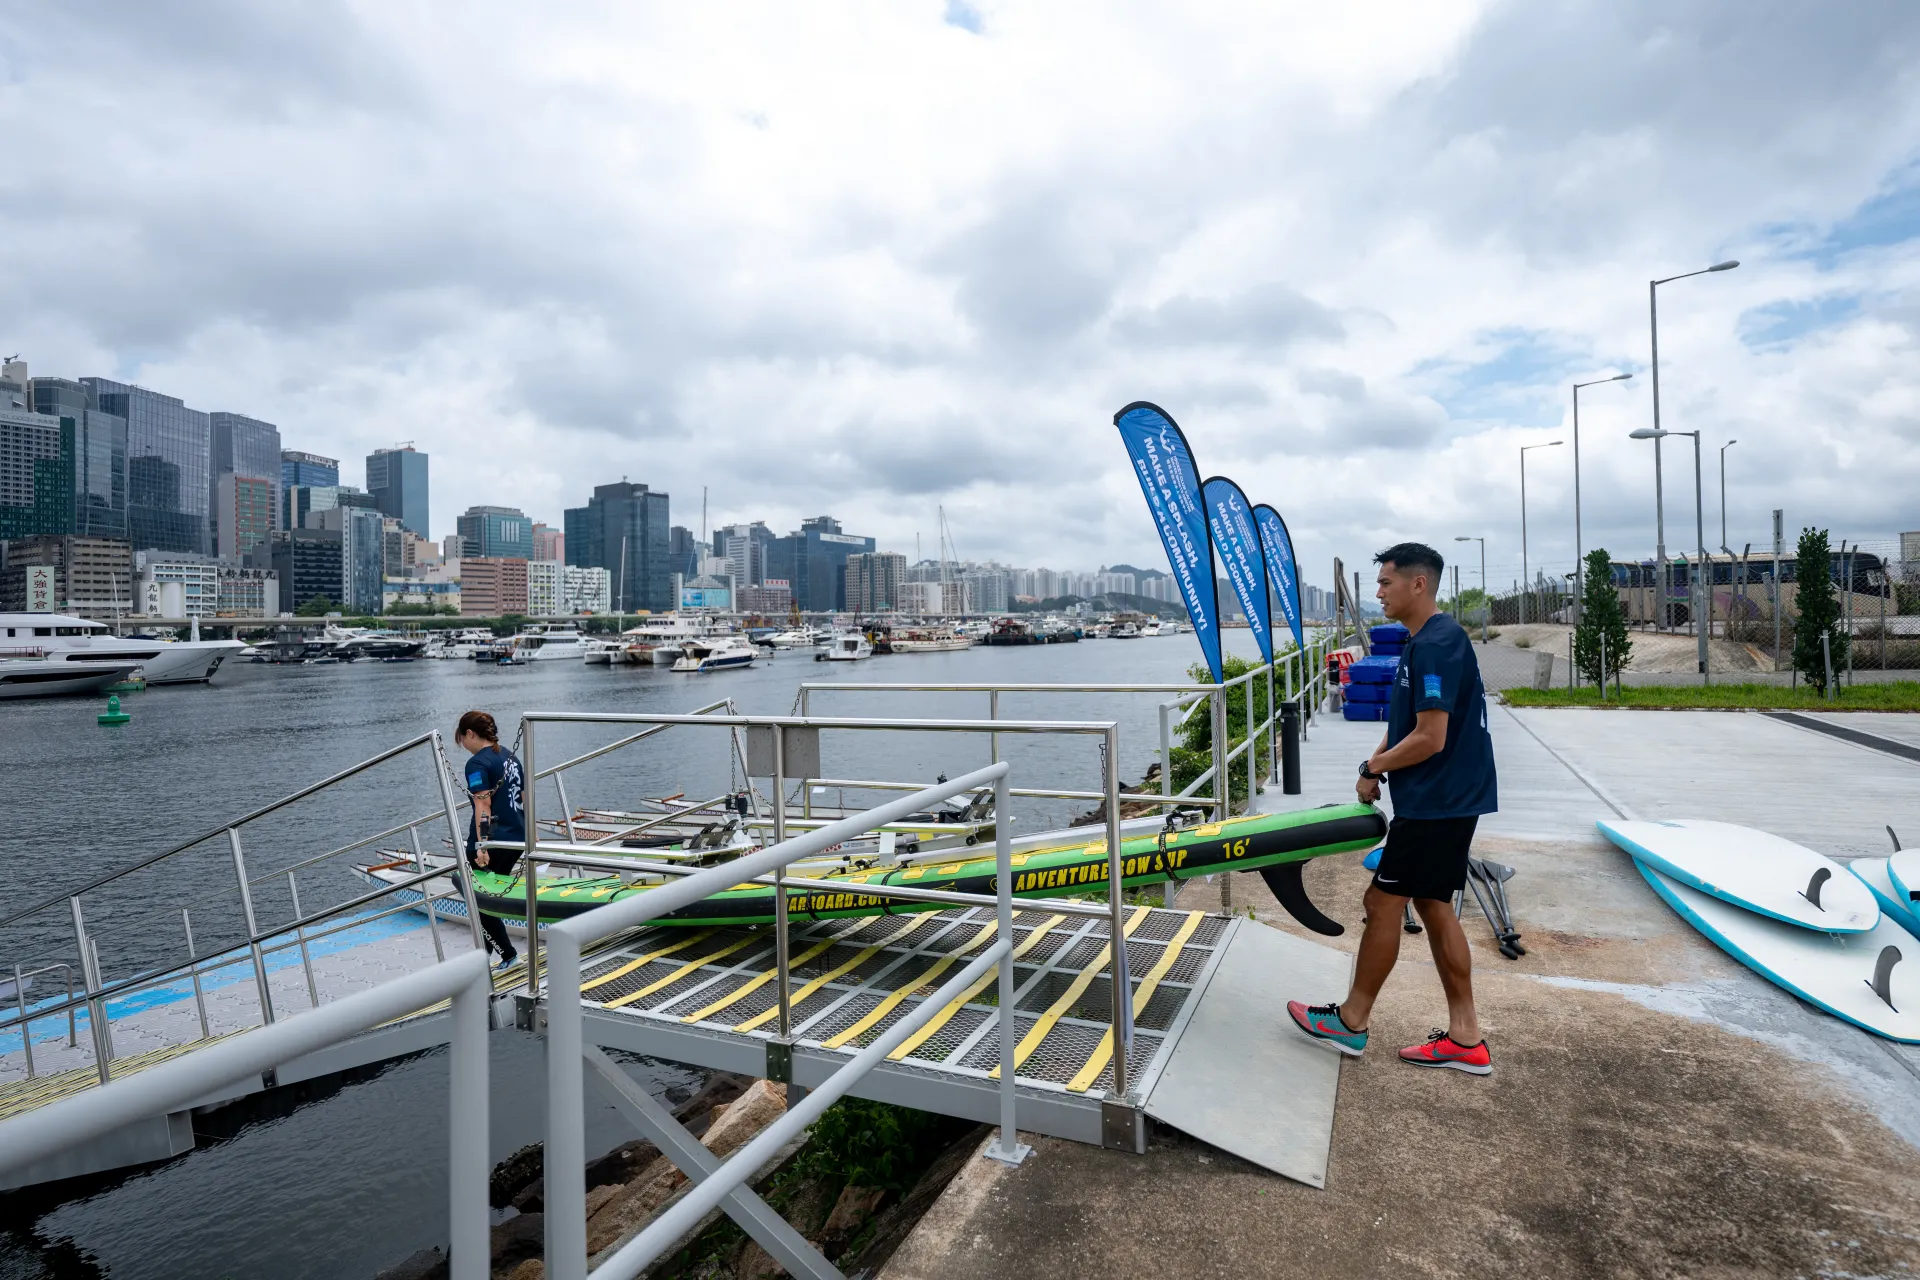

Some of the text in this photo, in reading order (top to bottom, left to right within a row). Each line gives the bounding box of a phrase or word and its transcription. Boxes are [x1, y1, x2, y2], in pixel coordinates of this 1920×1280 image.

[1144, 437, 1198, 567] MAKE A SPLASH,
[1217, 502, 1234, 535] MAKE
[1230, 537, 1237, 545] A
[1235, 546, 1256, 590] SPLASH,
[1261, 522, 1273, 546] MAKE
[1164, 525, 1207, 629] COMMUNITY!
[1211, 518, 1228, 551] BUILD
[1225, 554, 1232, 562] A
[1230, 563, 1262, 632] COMMUNITY!
[1015, 863, 1109, 891] ADVENTURE
[1155, 850, 1187, 871] SUP
